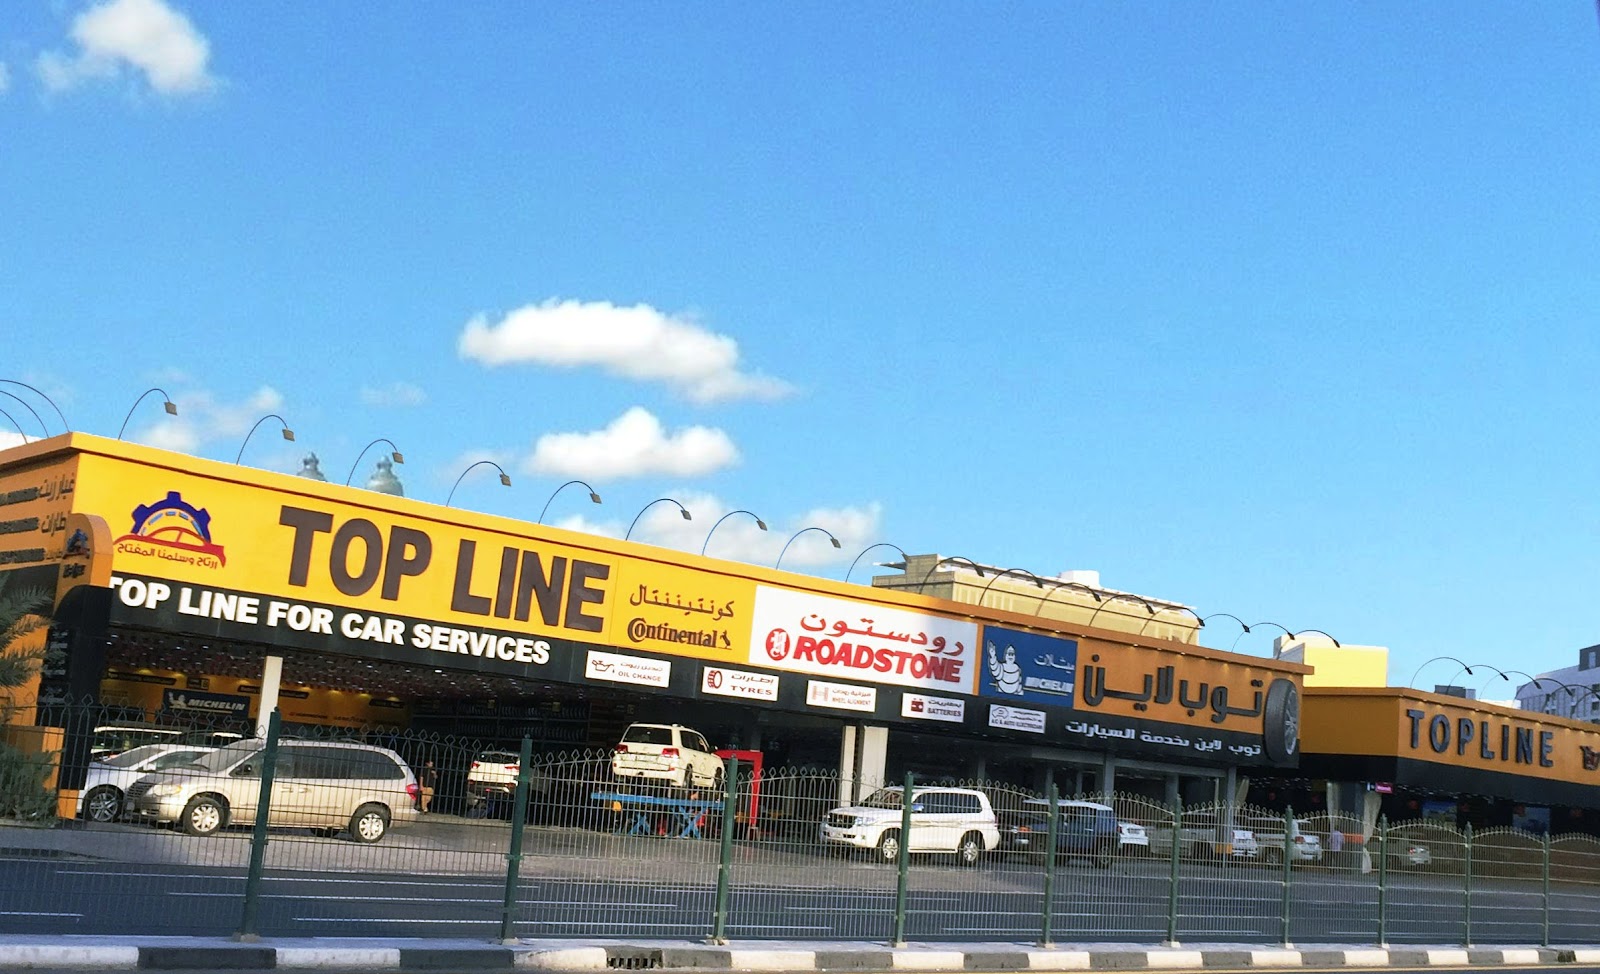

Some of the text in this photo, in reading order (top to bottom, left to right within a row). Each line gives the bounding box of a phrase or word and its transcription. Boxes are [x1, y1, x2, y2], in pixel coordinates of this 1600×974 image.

[42, 510, 67, 537] طارات
[117, 543, 218, 570] ارتاح وسلمنا المفتاح
[279, 505, 610, 633] TOP LINE
[629, 584, 735, 621] كونتيننتال
[178, 587, 259, 625] LINE
[267, 601, 333, 635] FOR
[341, 613, 406, 647] CAR
[411, 622, 551, 665] SERVICES
[627, 617, 718, 648] Continental
[800, 613, 964, 656] رودستون
[793, 635, 964, 683] ROADSTONE
[618, 670, 662, 682] OIL CHANGE
[1083, 654, 1264, 723] توب لاين
[731, 685, 773, 696] TYRES
[188, 698, 246, 711] MICHELIN
[927, 707, 962, 717] BATTERIES
[1065, 721, 1136, 740] السيارات
[1194, 738, 1222, 751] لاين
[1228, 744, 1261, 757] توب
